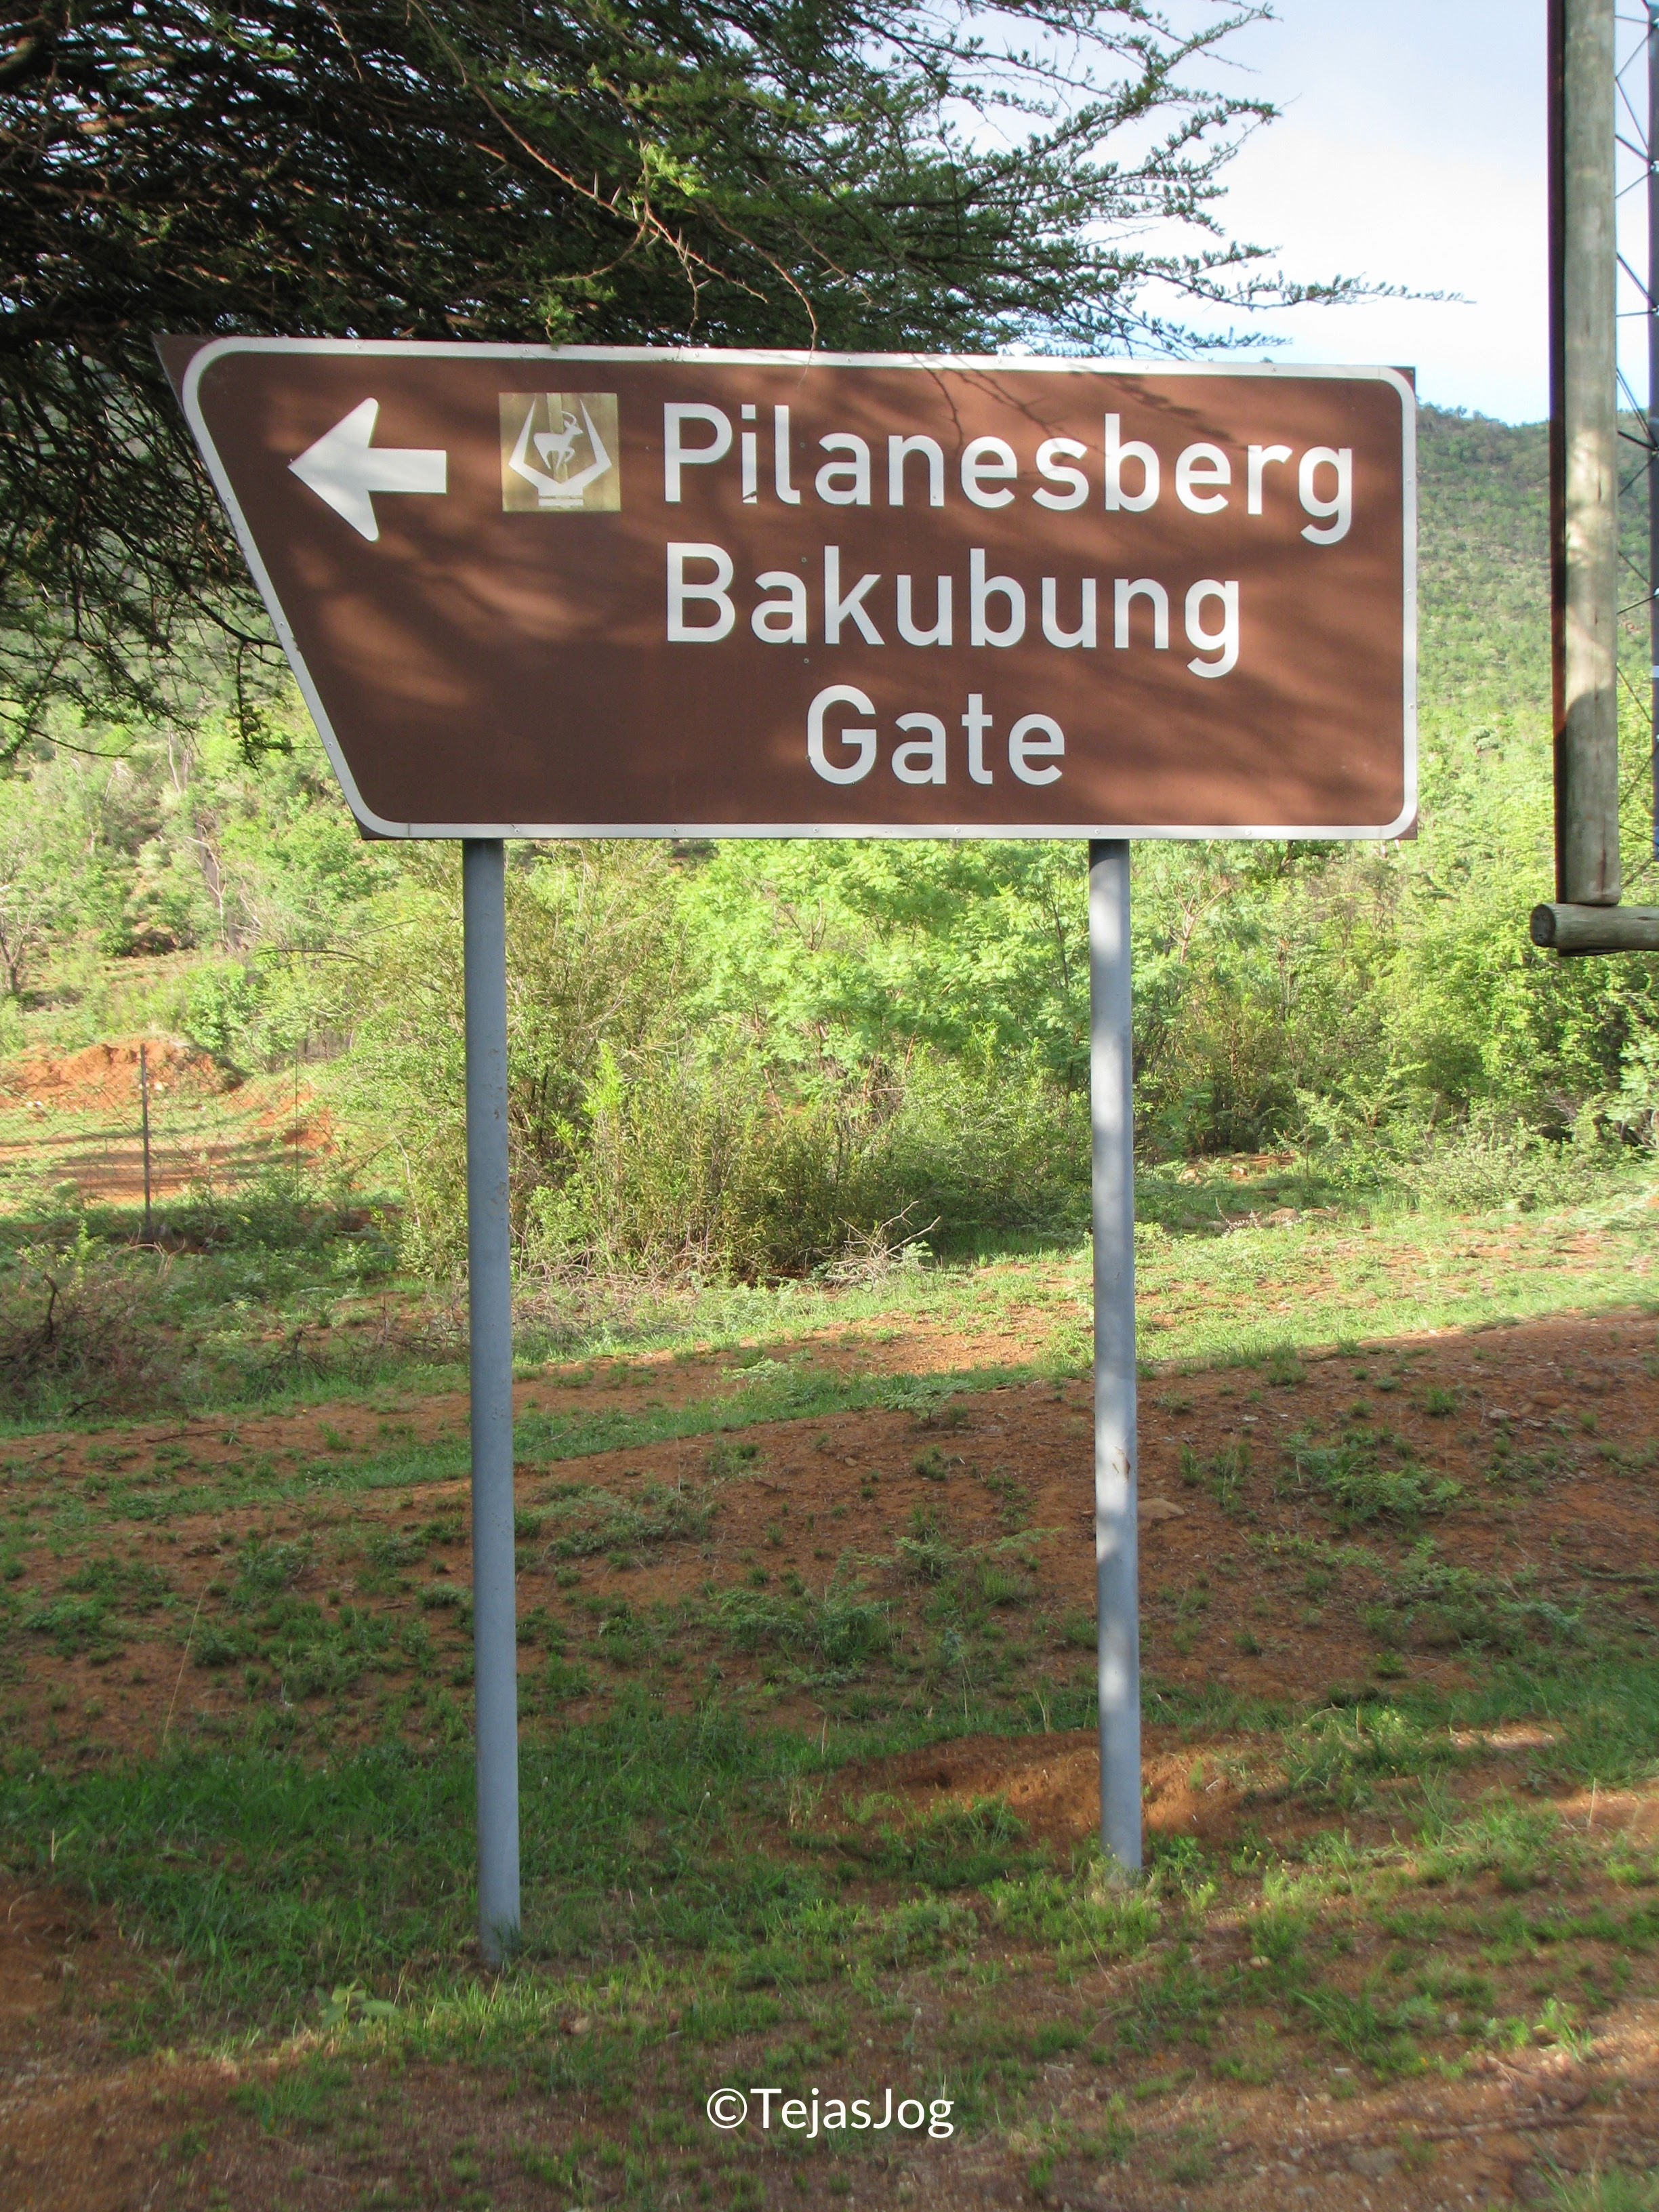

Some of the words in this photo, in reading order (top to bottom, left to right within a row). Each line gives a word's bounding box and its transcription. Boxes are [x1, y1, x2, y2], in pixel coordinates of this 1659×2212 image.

[663, 403, 1353, 545] Pilanesberg
[666, 541, 1240, 678] Bakubung
[807, 684, 1065, 785] Gate
